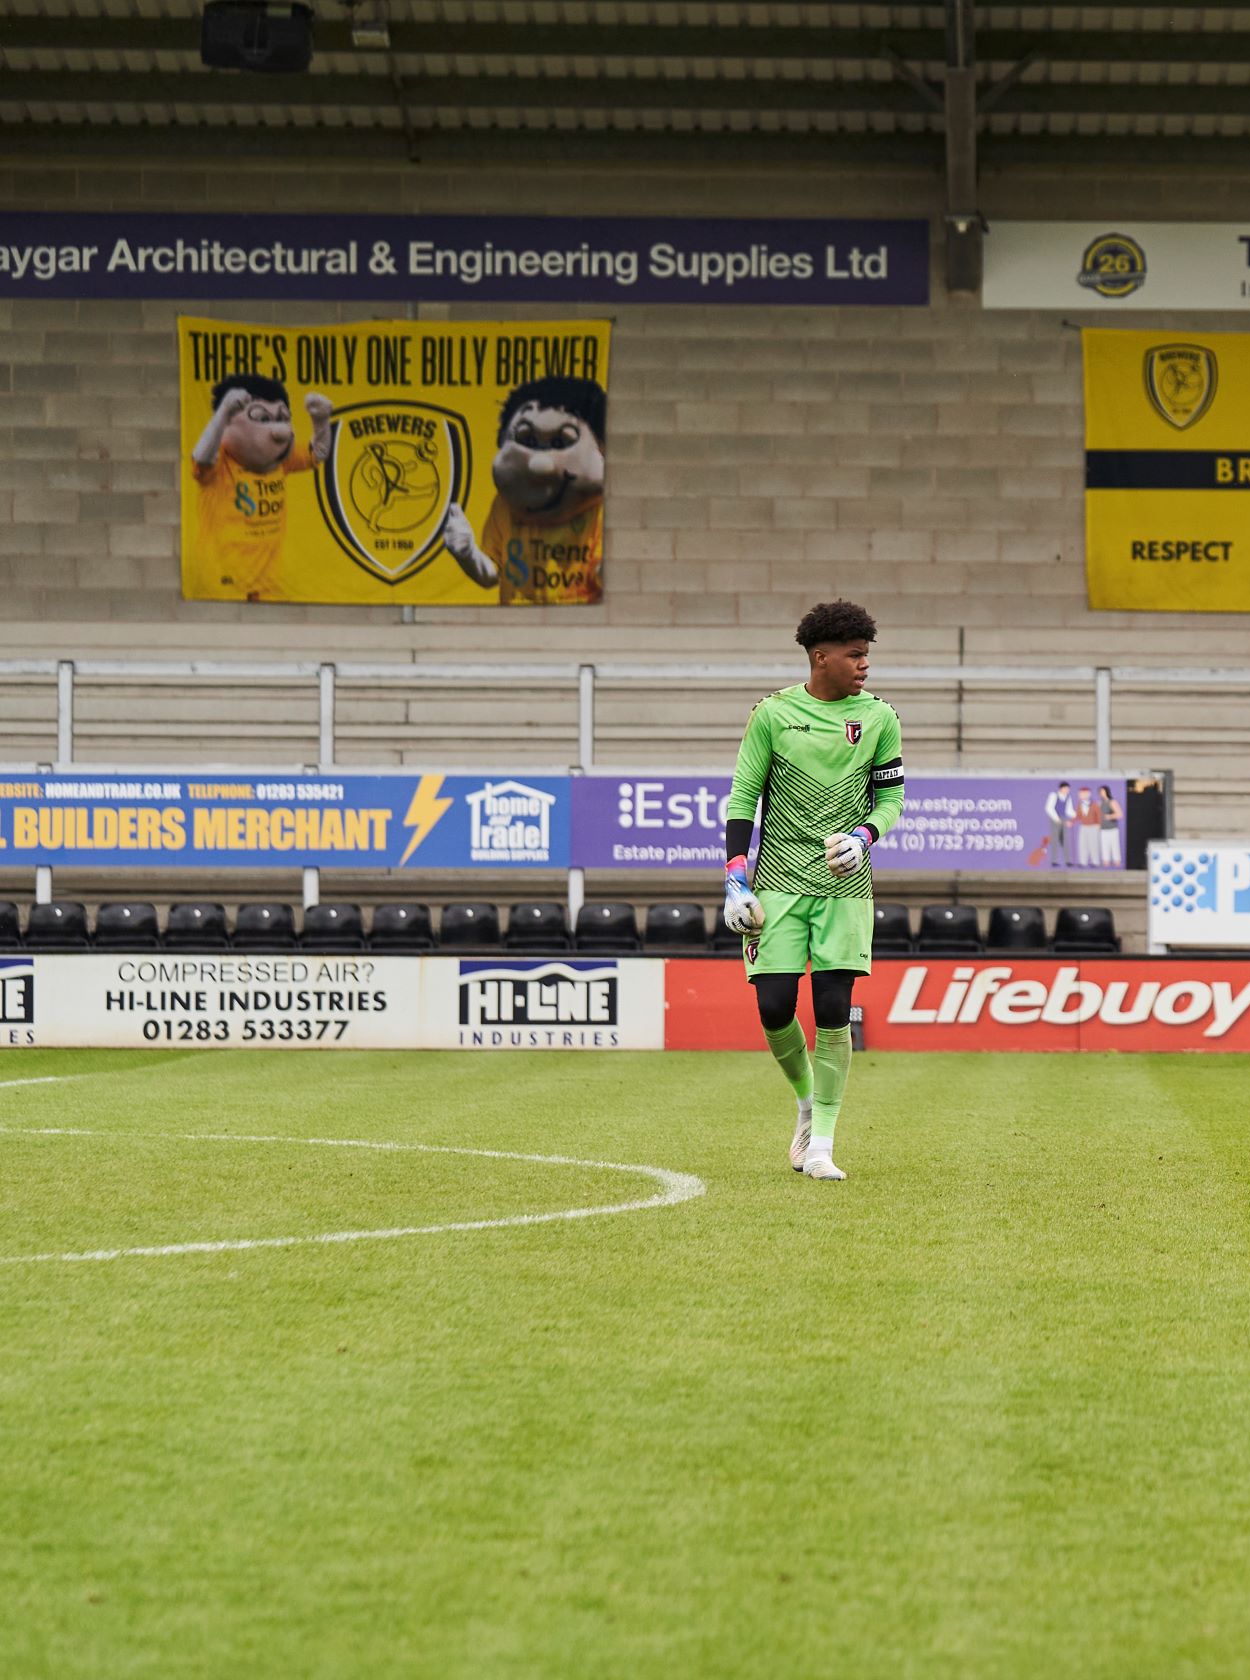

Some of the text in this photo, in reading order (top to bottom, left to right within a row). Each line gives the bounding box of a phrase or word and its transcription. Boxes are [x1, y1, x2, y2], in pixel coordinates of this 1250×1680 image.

[107, 238, 357, 274] Architectural
[368, 241, 397, 274] &
[409, 242, 638, 284] Engineering
[649, 241, 814, 285] Supplies
[825, 245, 888, 279] Ltd
[188, 331, 599, 386] THERE'S ONLY ONE BILLY BREWER
[350, 413, 437, 440] BREWERS
[1131, 540, 1232, 562] RESPECT
[484, 782, 541, 816] home
[14, 806, 187, 850] BUILDERS
[193, 806, 393, 851] MERCHANT
[612, 844, 665, 861] Estate
[666, 843, 728, 864] plannin
[901, 833, 925, 852] (0)
[928, 835, 964, 851] 1732
[966, 835, 1025, 851] 793909
[118, 961, 375, 983] COMPRESSED AIR?
[106, 990, 388, 1012] HI-LINE INDUSTRIES
[142, 1019, 350, 1041] 01283 533377
[459, 1031, 620, 1046] INDUSTRIES
